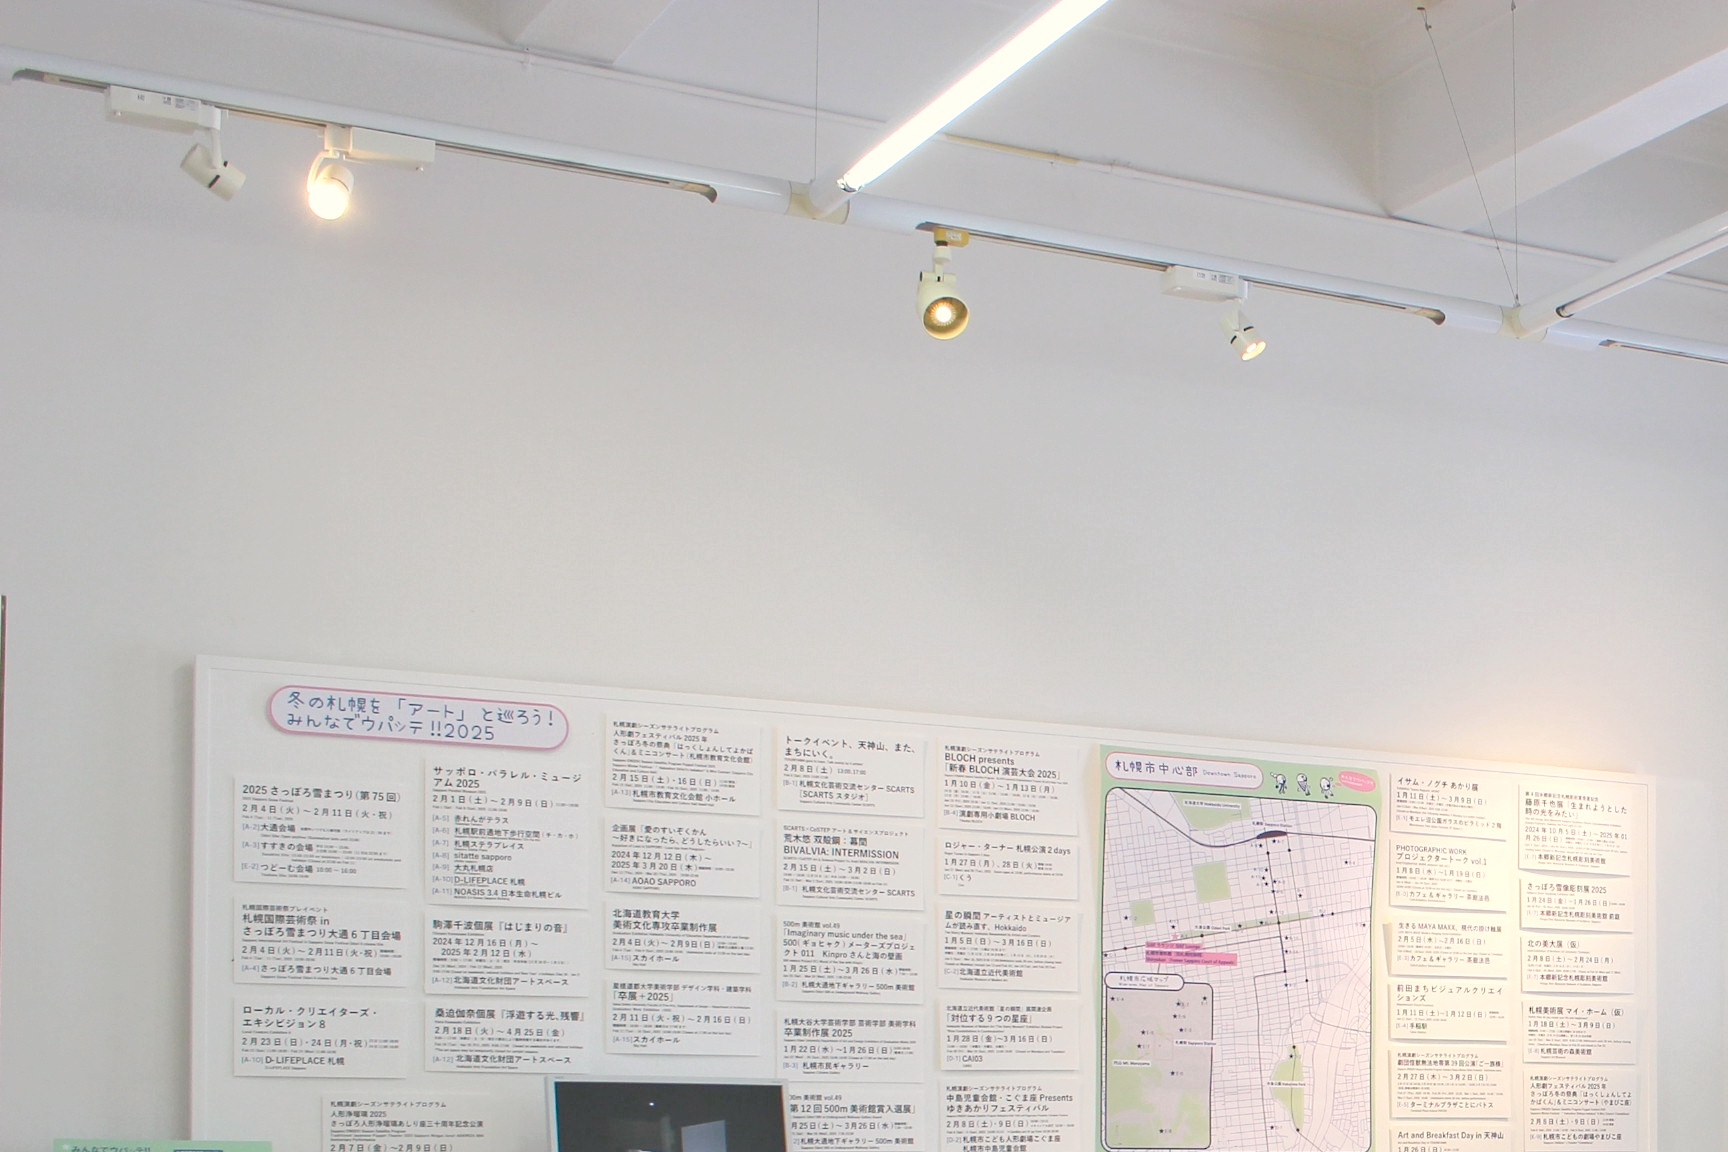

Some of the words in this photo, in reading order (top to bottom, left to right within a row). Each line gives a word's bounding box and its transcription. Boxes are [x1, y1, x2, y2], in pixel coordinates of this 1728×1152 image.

[785, 748, 833, 759] まちにいく。
[945, 753, 975, 762] BLOCH
[979, 756, 1014, 765] presents
[969, 765, 999, 774] BLOCH
[1116, 760, 1198, 777] 札幌市中心部
[434, 778, 452, 787] アム
[457, 779, 479, 788] 2025
[633, 790, 703, 801] 札幌市教育文化会館
[455, 815, 508, 824] 赤れんがテラス
[1011, 813, 1035, 821] BLOCH
[261, 824, 295, 832] 大通会場
[261, 842, 313, 851] すすきの会場
[455, 840, 524, 849] 札幌ステラプレイス
[784, 846, 828, 855] BIVALVIA:
[832, 848, 899, 859] INTERMISSION
[1016, 845, 1046, 853] 札幌公演
[1054, 847, 1071, 855] days
[261, 864, 313, 873] つどーむ会場
[632, 877, 655, 885] AOAO
[658, 878, 696, 887] SAPPORO
[1592, 886, 1606, 894] 2025
[612, 909, 679, 919] 北海道教育大学
[945, 911, 980, 920] 星の瞬間
[243, 915, 317, 924] 札幌国際芸術祭
[320, 917, 329, 925] in
[823, 951, 847, 959] Kinpro
[960, 968, 1023, 977] 北海道立近代美術館
[454, 977, 568, 986] 北海道文化財団アートスペース
[784, 1028, 829, 1037] 卒業制作展
[832, 1029, 852, 1037] 2025
[456, 1055, 571, 1064] 北海道文化財団アートスペース
[803, 1062, 869, 1070] 札幌市民ギャラリー
[947, 1105, 1049, 1113] ゆきあかりフェスティバル
[1461, 1132, 1474, 1140] Day
